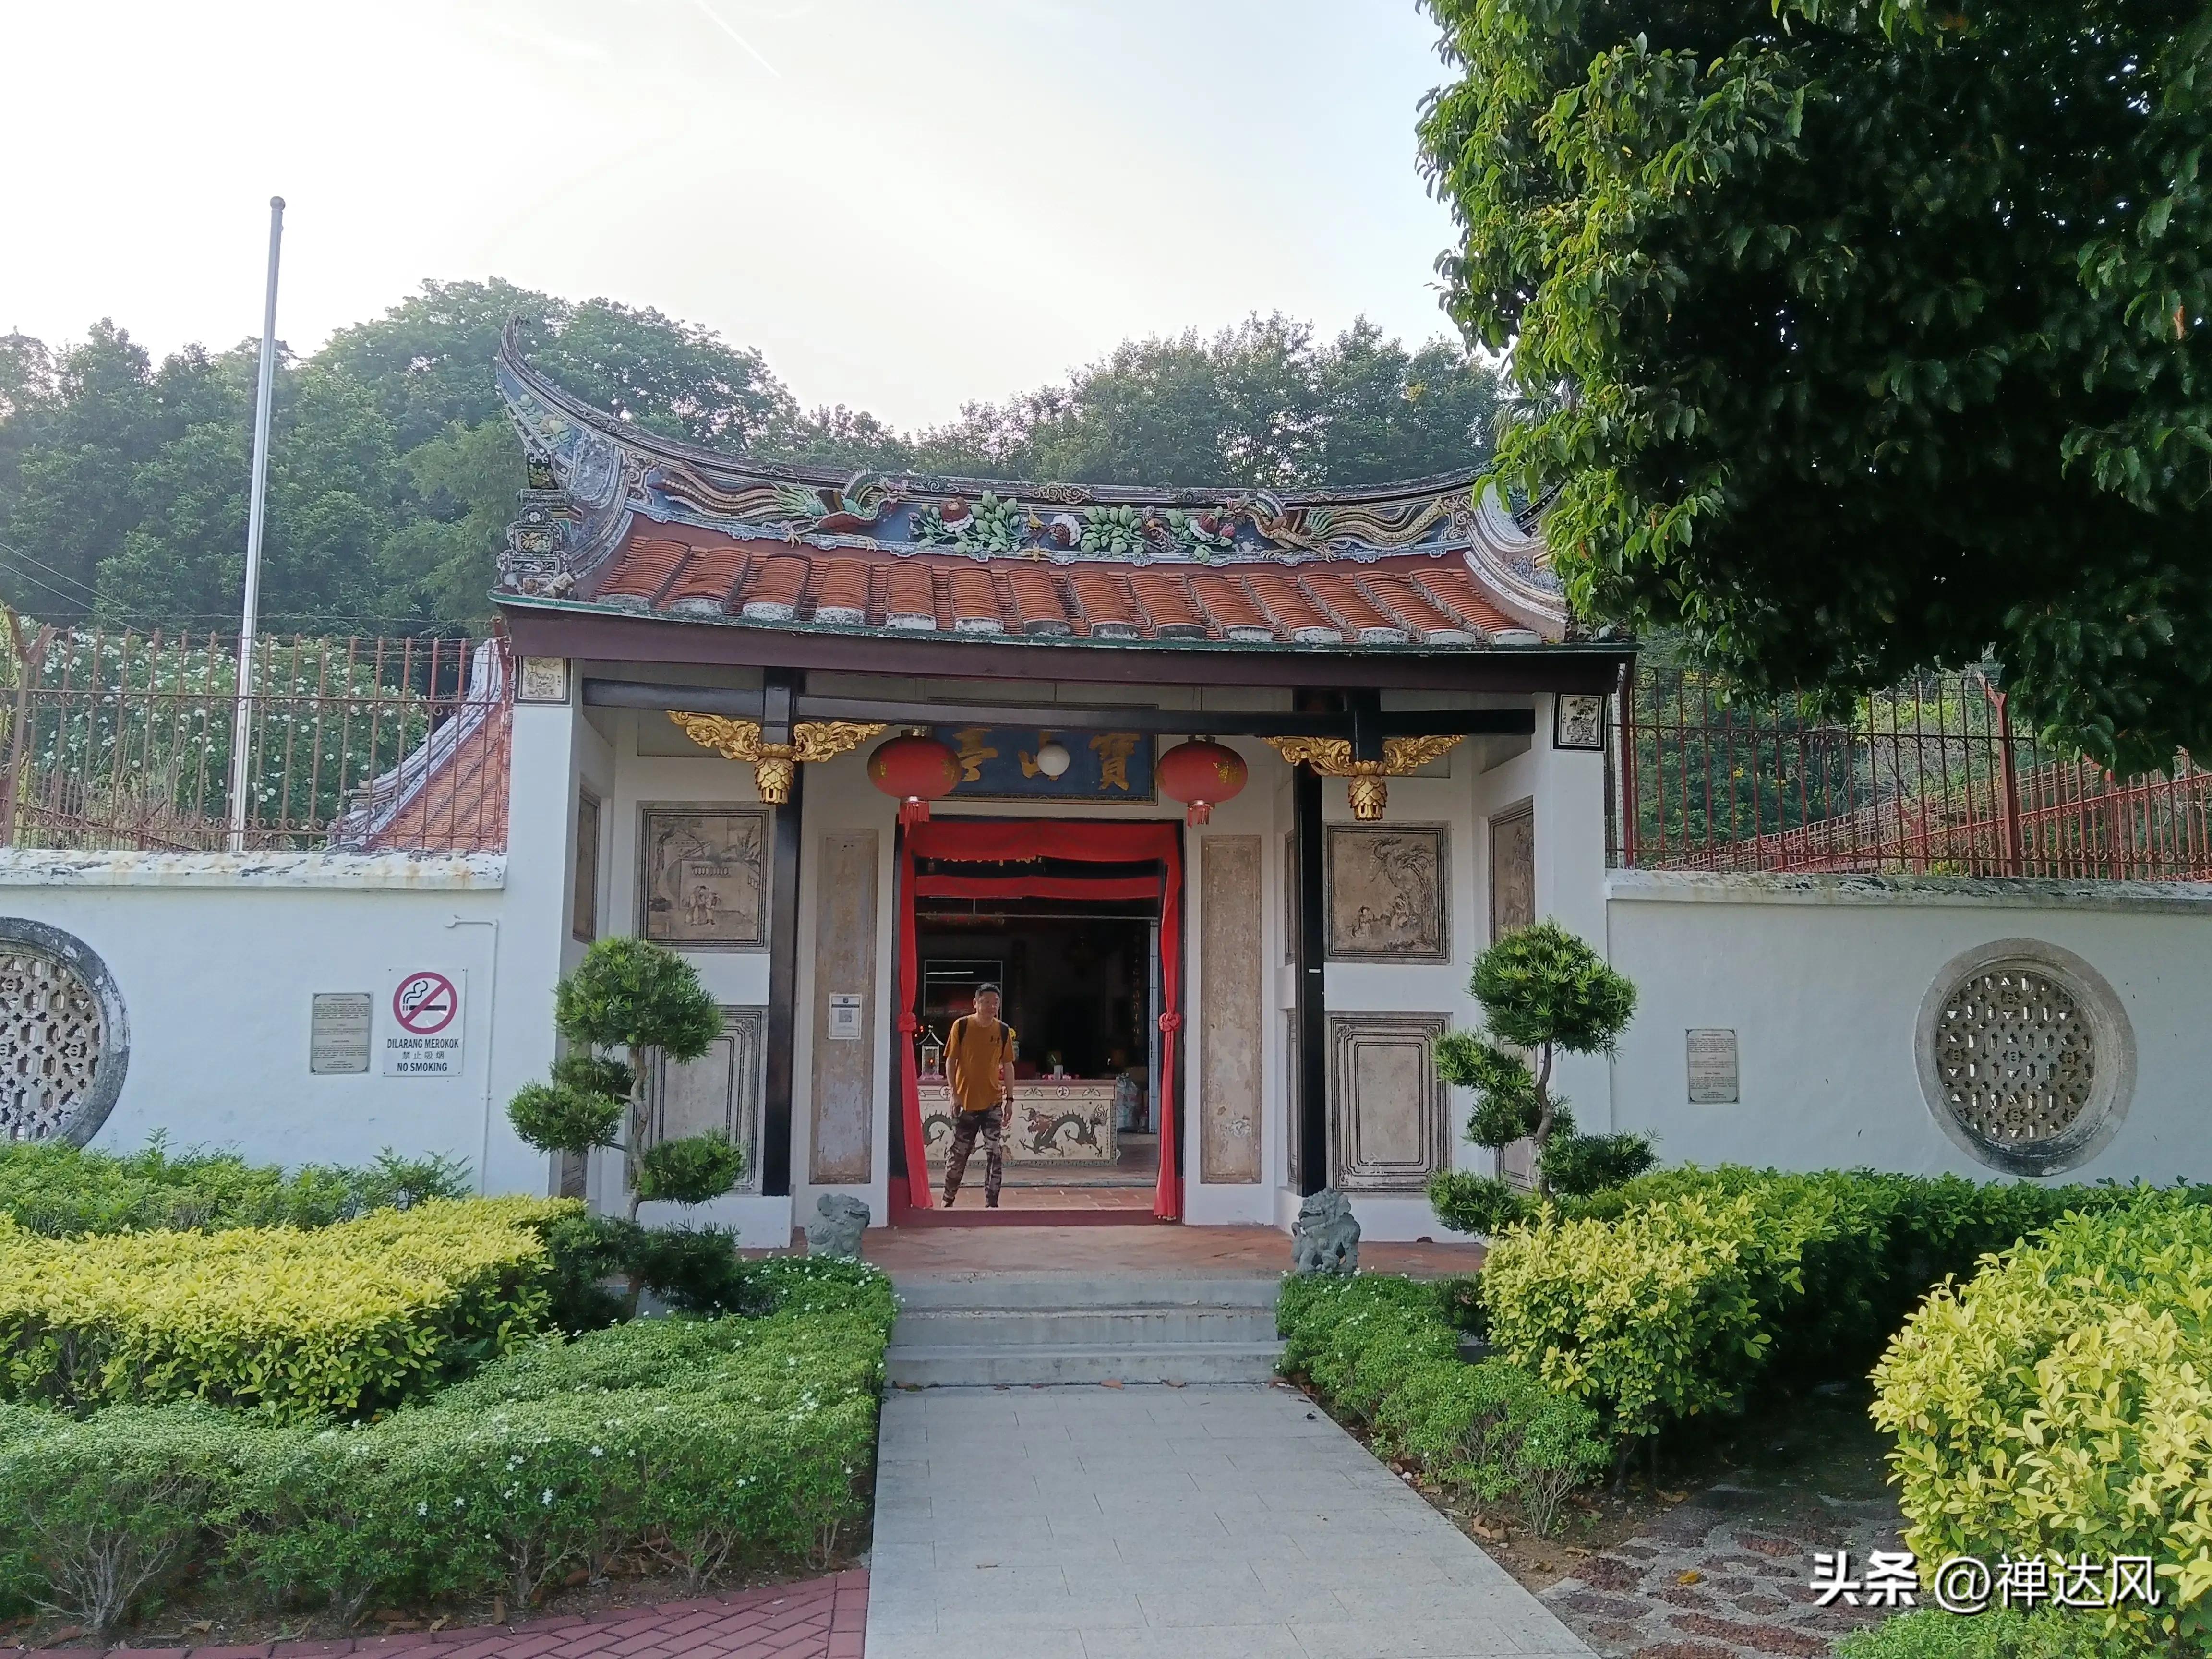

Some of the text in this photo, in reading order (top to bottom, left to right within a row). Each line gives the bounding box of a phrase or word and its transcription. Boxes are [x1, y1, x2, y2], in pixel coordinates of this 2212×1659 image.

[387, 1038, 459, 1048] DILARANG MEROKOK
[402, 1051, 445, 1059] 禁止吸烟
[397, 1062, 447, 1071] NO SMOKING
